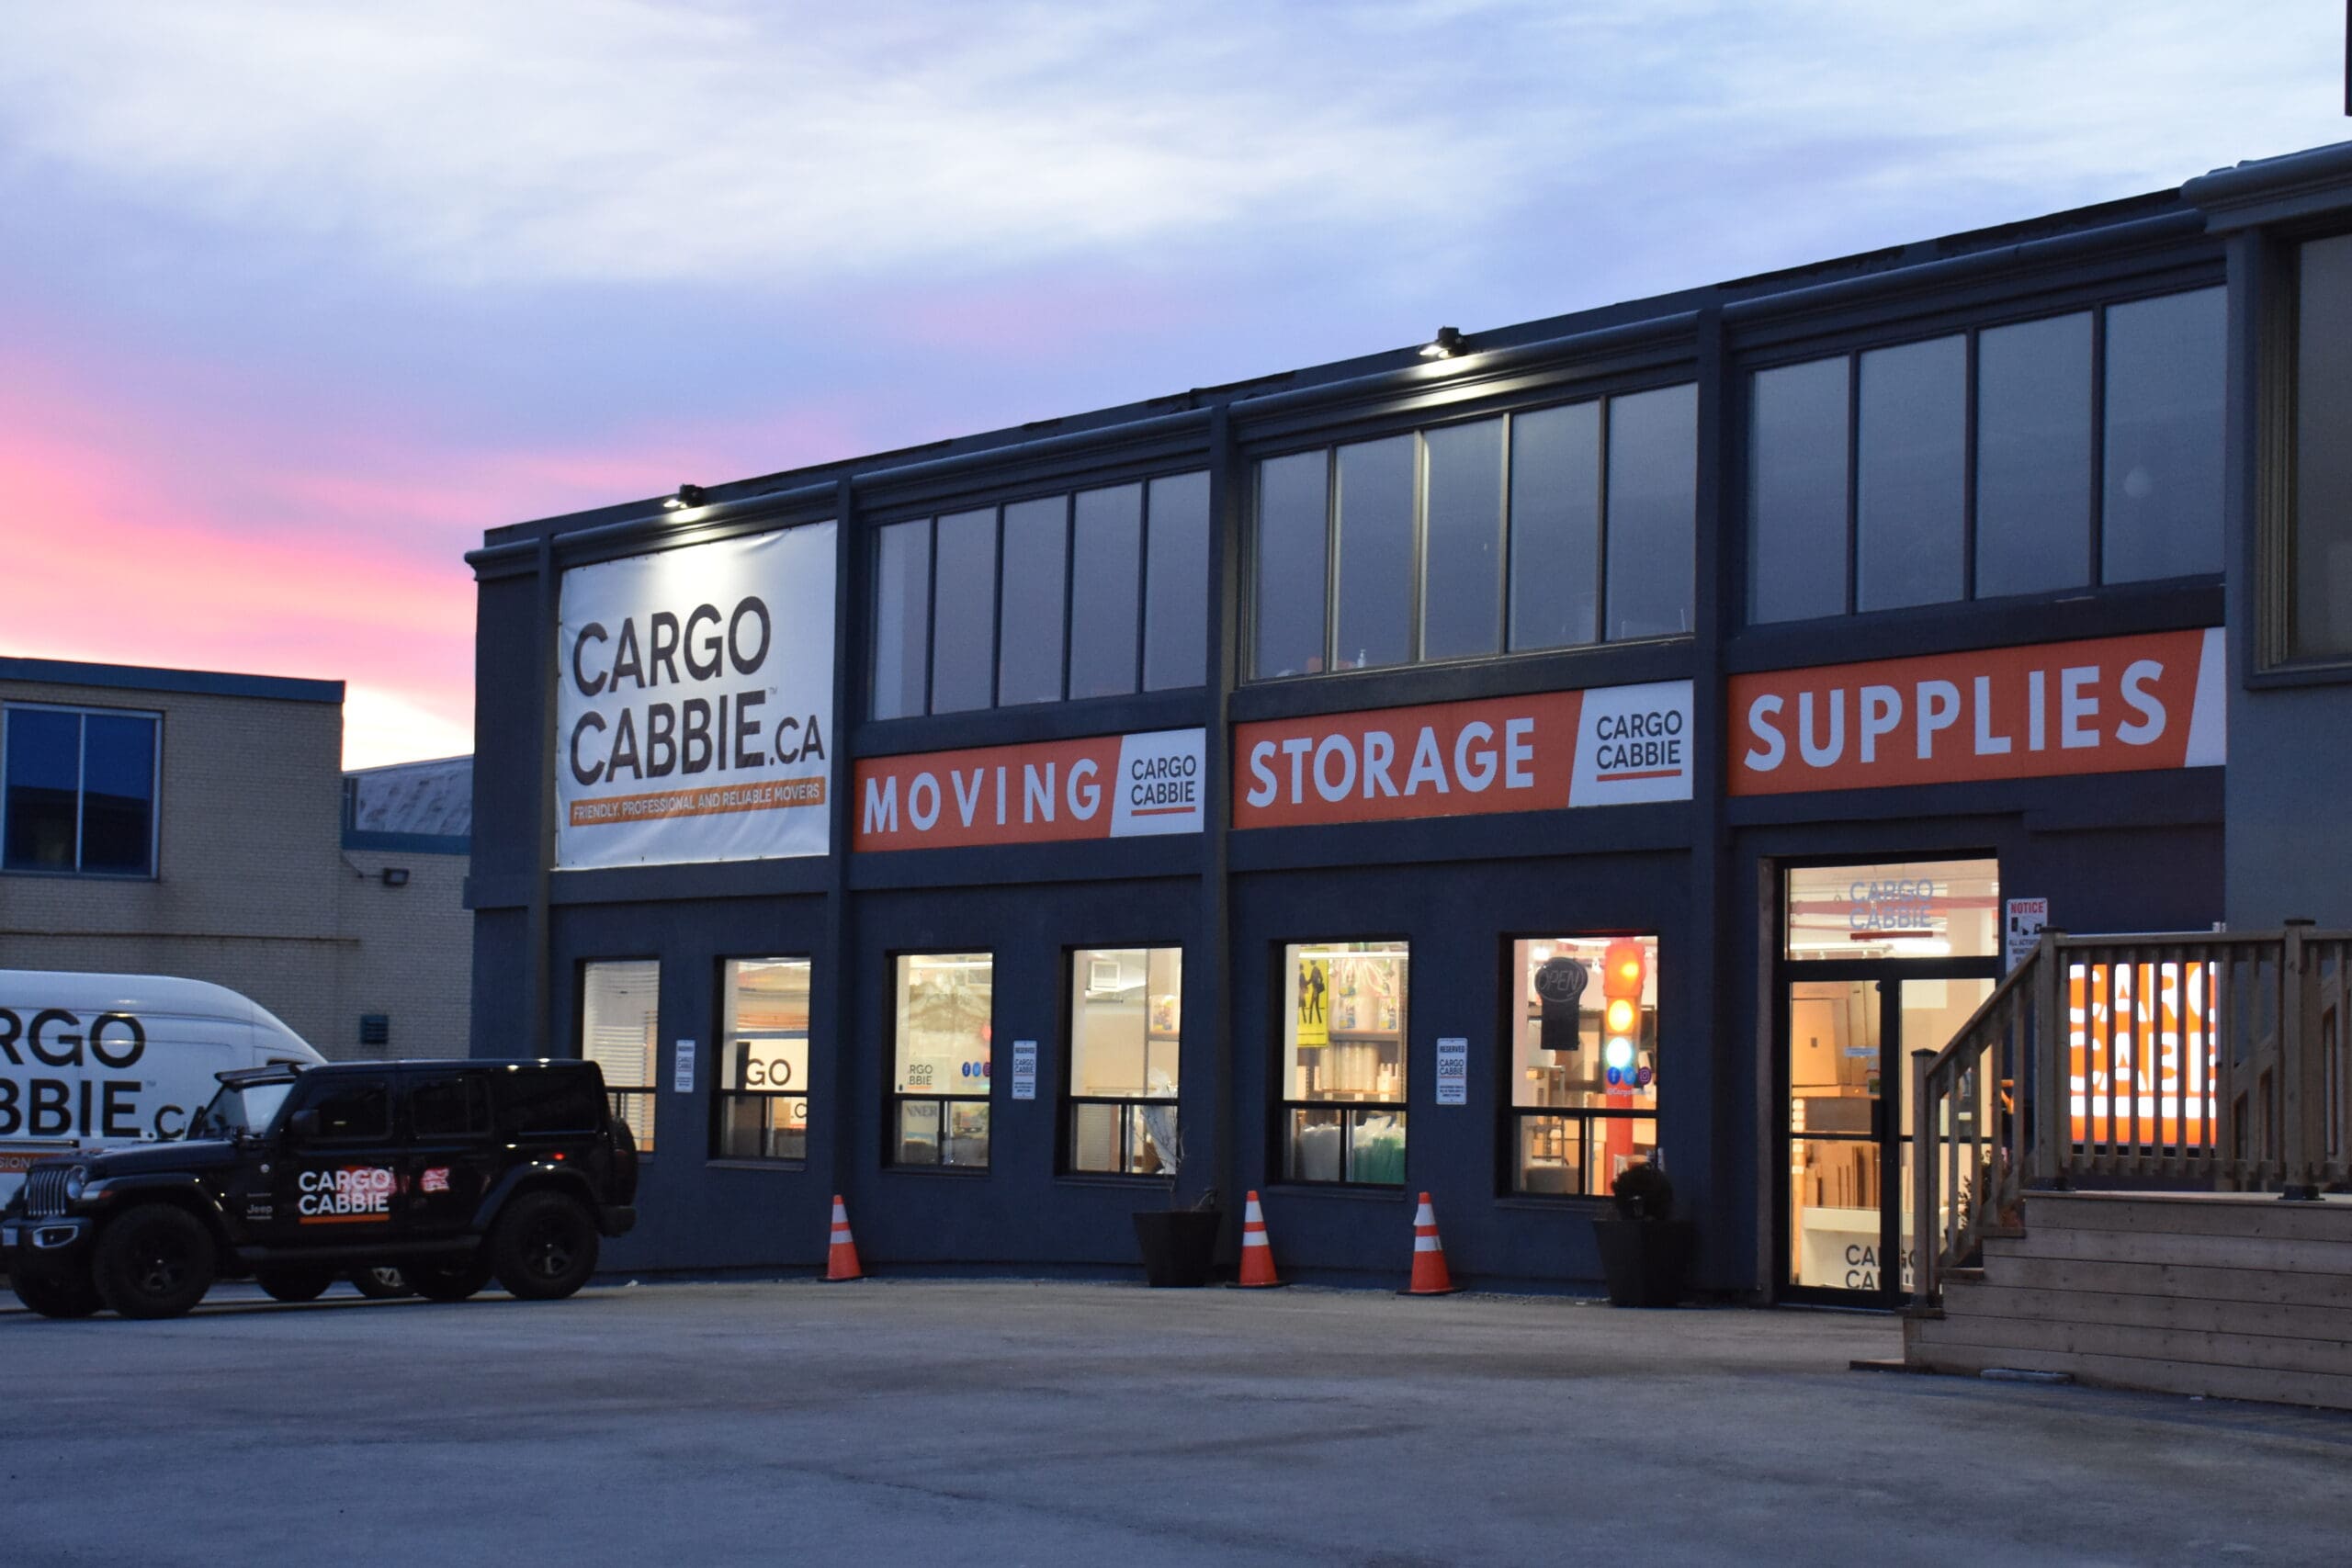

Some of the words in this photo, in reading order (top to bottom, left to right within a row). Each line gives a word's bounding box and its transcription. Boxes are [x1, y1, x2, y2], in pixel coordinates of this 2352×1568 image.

[573, 595, 771, 697] CARGO
[1597, 710, 1683, 741] CARGO
[1744, 659, 2167, 772] SUPPLIES
[571, 690, 825, 786] CABBIE.CA
[1131, 754, 1196, 782] CARGO
[1247, 717, 1534, 808] STORAGE
[1597, 739, 1681, 770] CABBIE
[622, 796, 695, 816] PROFESSIONAL
[698, 793, 719, 807] AND
[723, 787, 772, 805] RELIABLE
[775, 784, 820, 800] MOVERS
[863, 758, 1101, 834] MOVING
[1131, 780, 1195, 806] CABBIE
[1850, 878, 1933, 904] CARGO
[1850, 906, 1932, 930] CABBIE
[2011, 902, 2044, 914] NOTICE
[1440, 1058, 1464, 1066] CARGO
[299, 1168, 390, 1192] CARGO
[246, 1204, 273, 1214] Jeep
[299, 1193, 390, 1215] CABBIE
